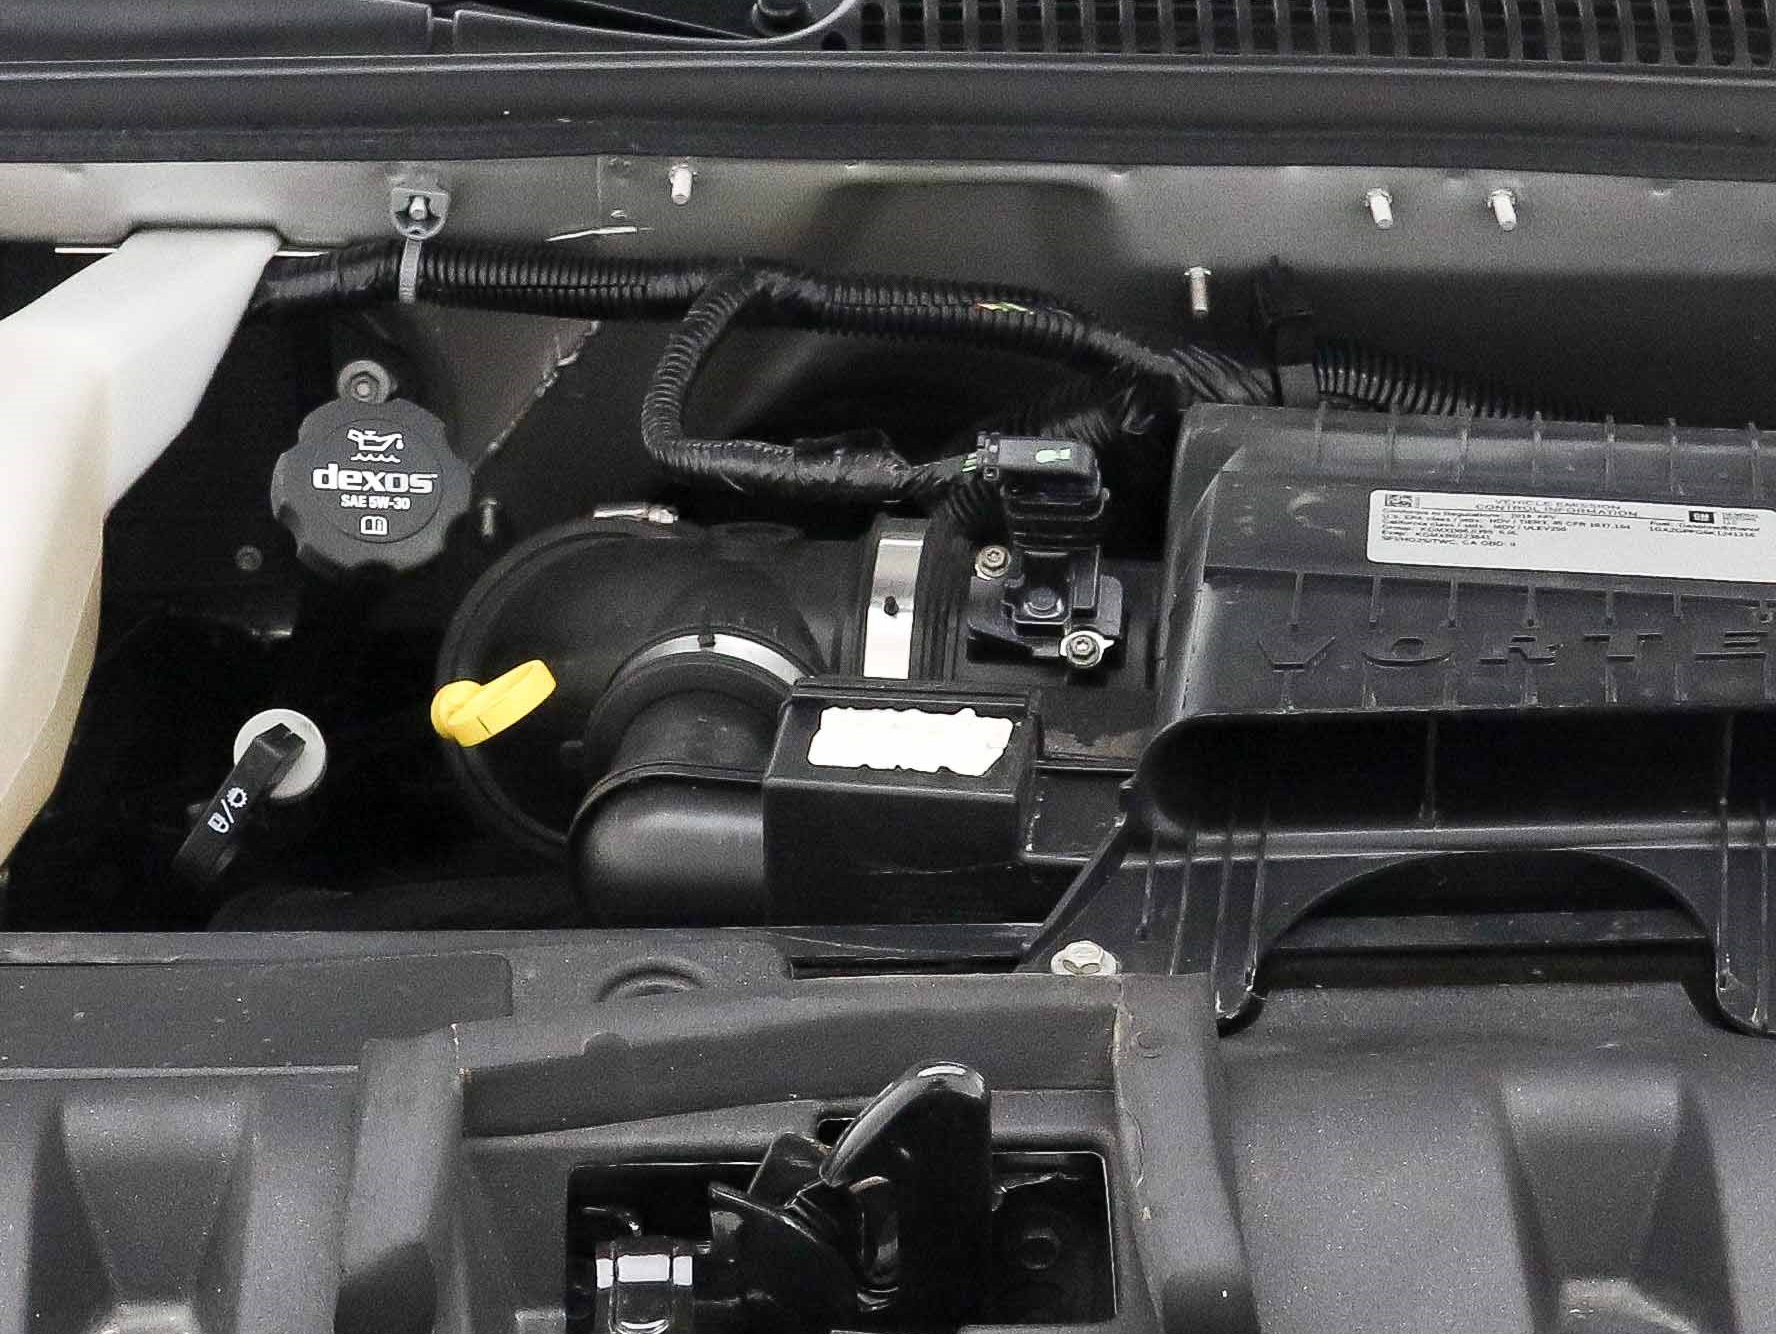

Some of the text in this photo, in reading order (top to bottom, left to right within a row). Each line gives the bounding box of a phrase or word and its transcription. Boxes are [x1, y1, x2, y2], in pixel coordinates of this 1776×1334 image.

[312, 463, 437, 494] dexos
[340, 495, 411, 510] SAE 5W-30
